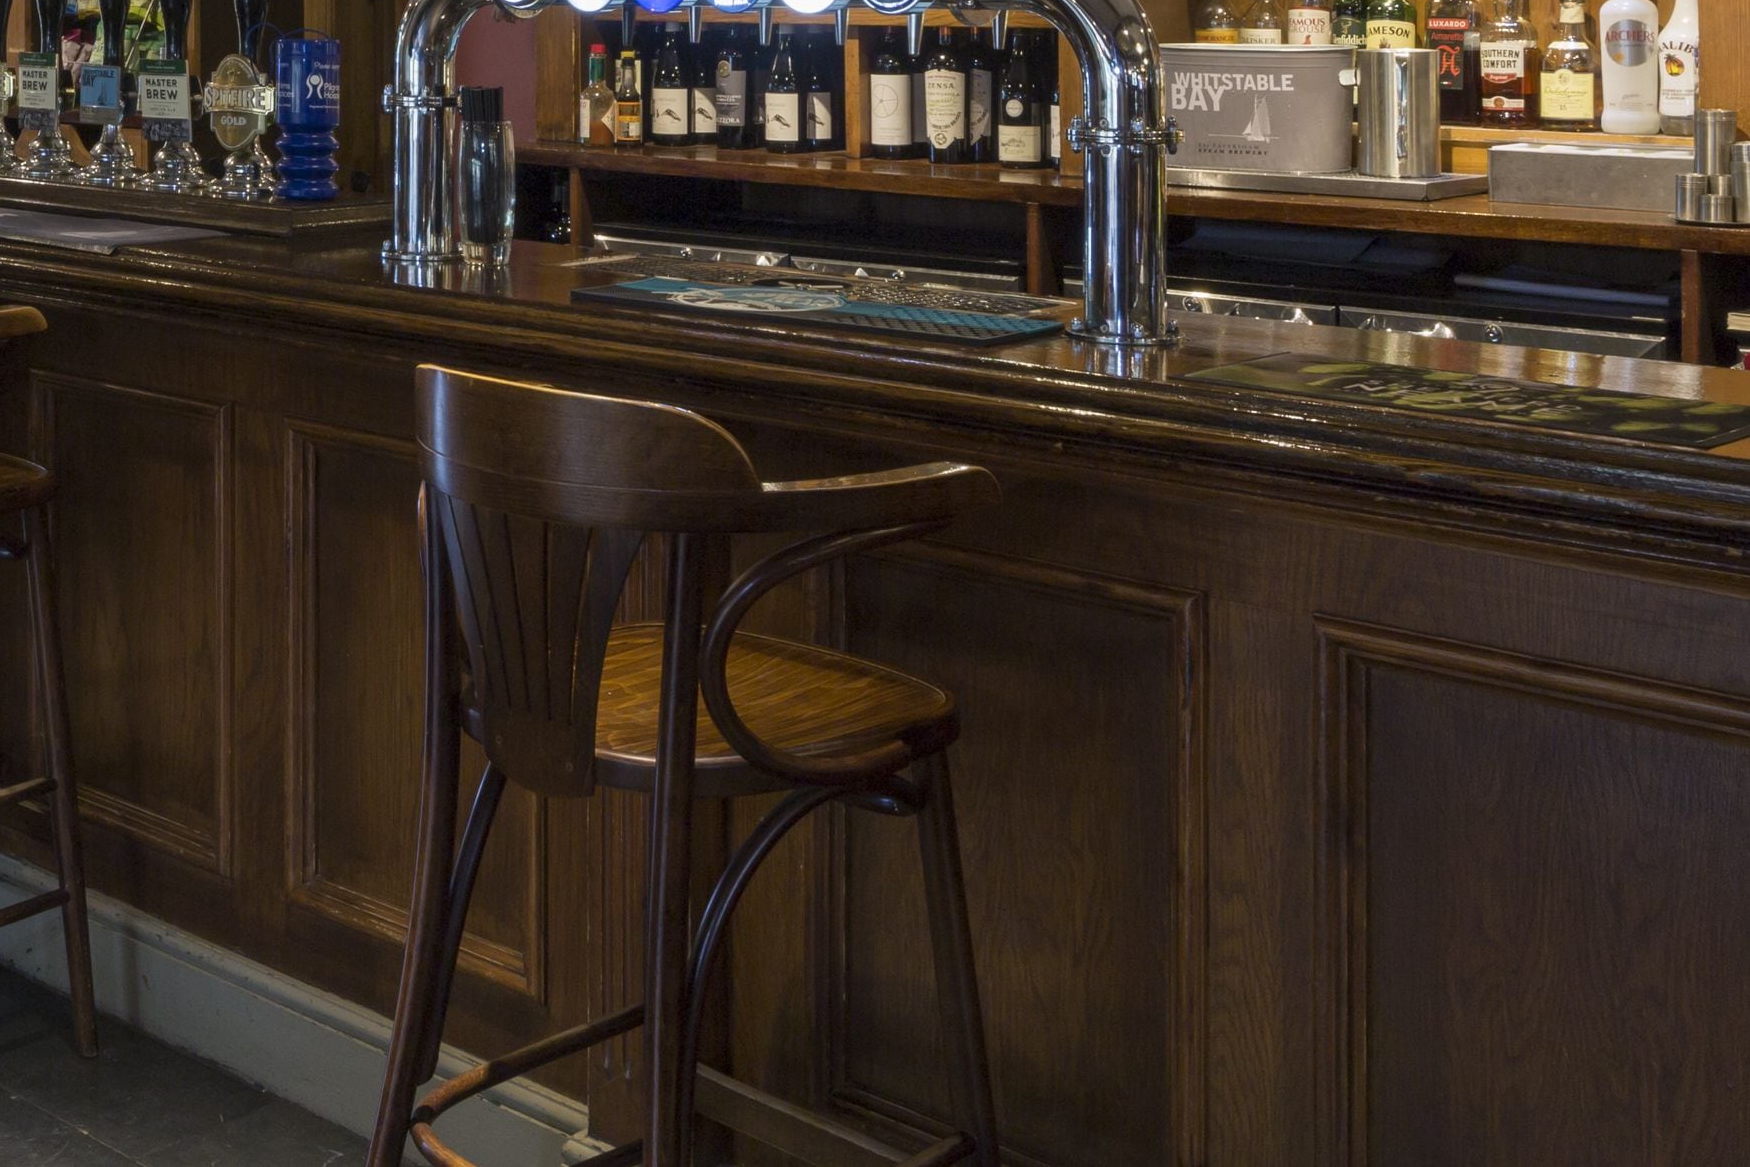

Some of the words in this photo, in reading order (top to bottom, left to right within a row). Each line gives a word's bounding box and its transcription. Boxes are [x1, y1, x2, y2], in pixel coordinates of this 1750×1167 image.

[1289, 17, 1325, 27] FAMOUS
[1428, 20, 1466, 28] LUXARDO
[1369, 25, 1411, 39] AMESON
[1431, 32, 1464, 40] Amaretto
[1604, 29, 1656, 44] ARCHERS
[1481, 48, 1520, 59] SOUTHERN
[1483, 59, 1517, 69] COMFORT
[22, 70, 48, 79] MASTER
[22, 80, 48, 91] BREW
[145, 78, 178, 88] MASTER
[1174, 71, 1294, 91] WHITSTABLE
[146, 88, 178, 100] BREW
[203, 86, 266, 110] SPITFIRE
[1171, 83, 1225, 111] BAY
[220, 115, 247, 126] GOLD
